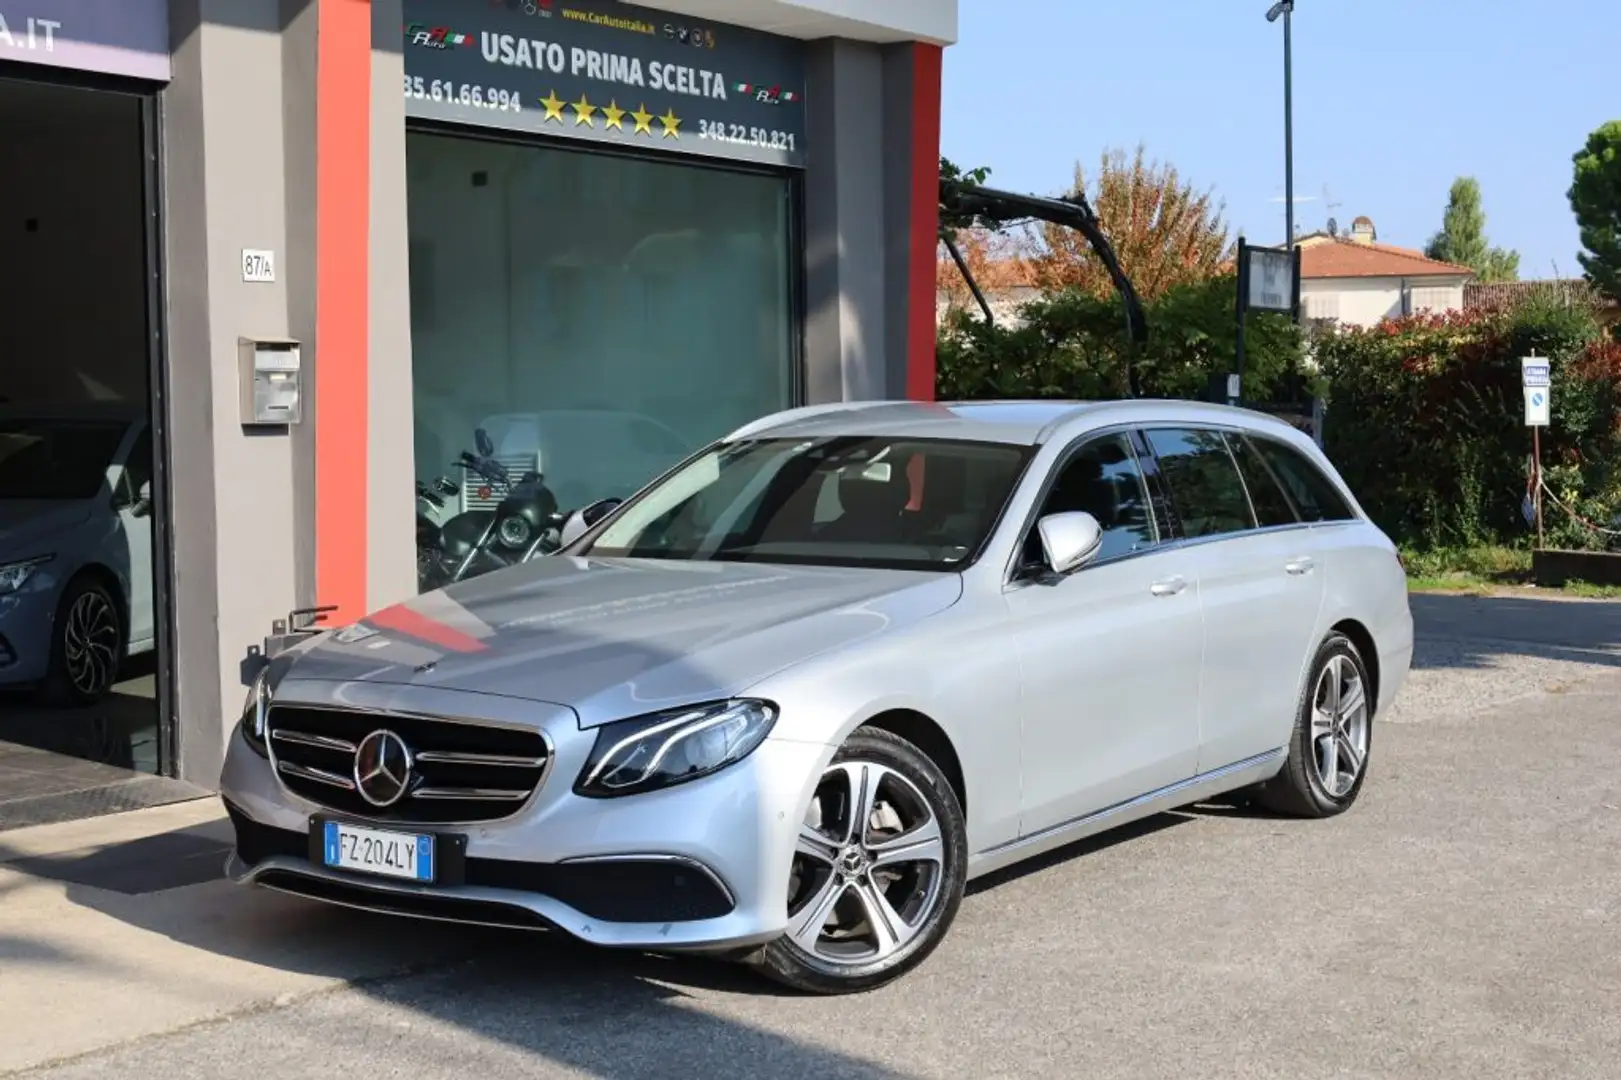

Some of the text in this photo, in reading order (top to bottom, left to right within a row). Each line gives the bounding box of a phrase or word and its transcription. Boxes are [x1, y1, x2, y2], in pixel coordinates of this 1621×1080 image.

[481, 31, 727, 100] USATO PRIMA SCELTA
[699, 118, 795, 152] 348.22.50.821
[245, 255, 272, 277] 87/A
